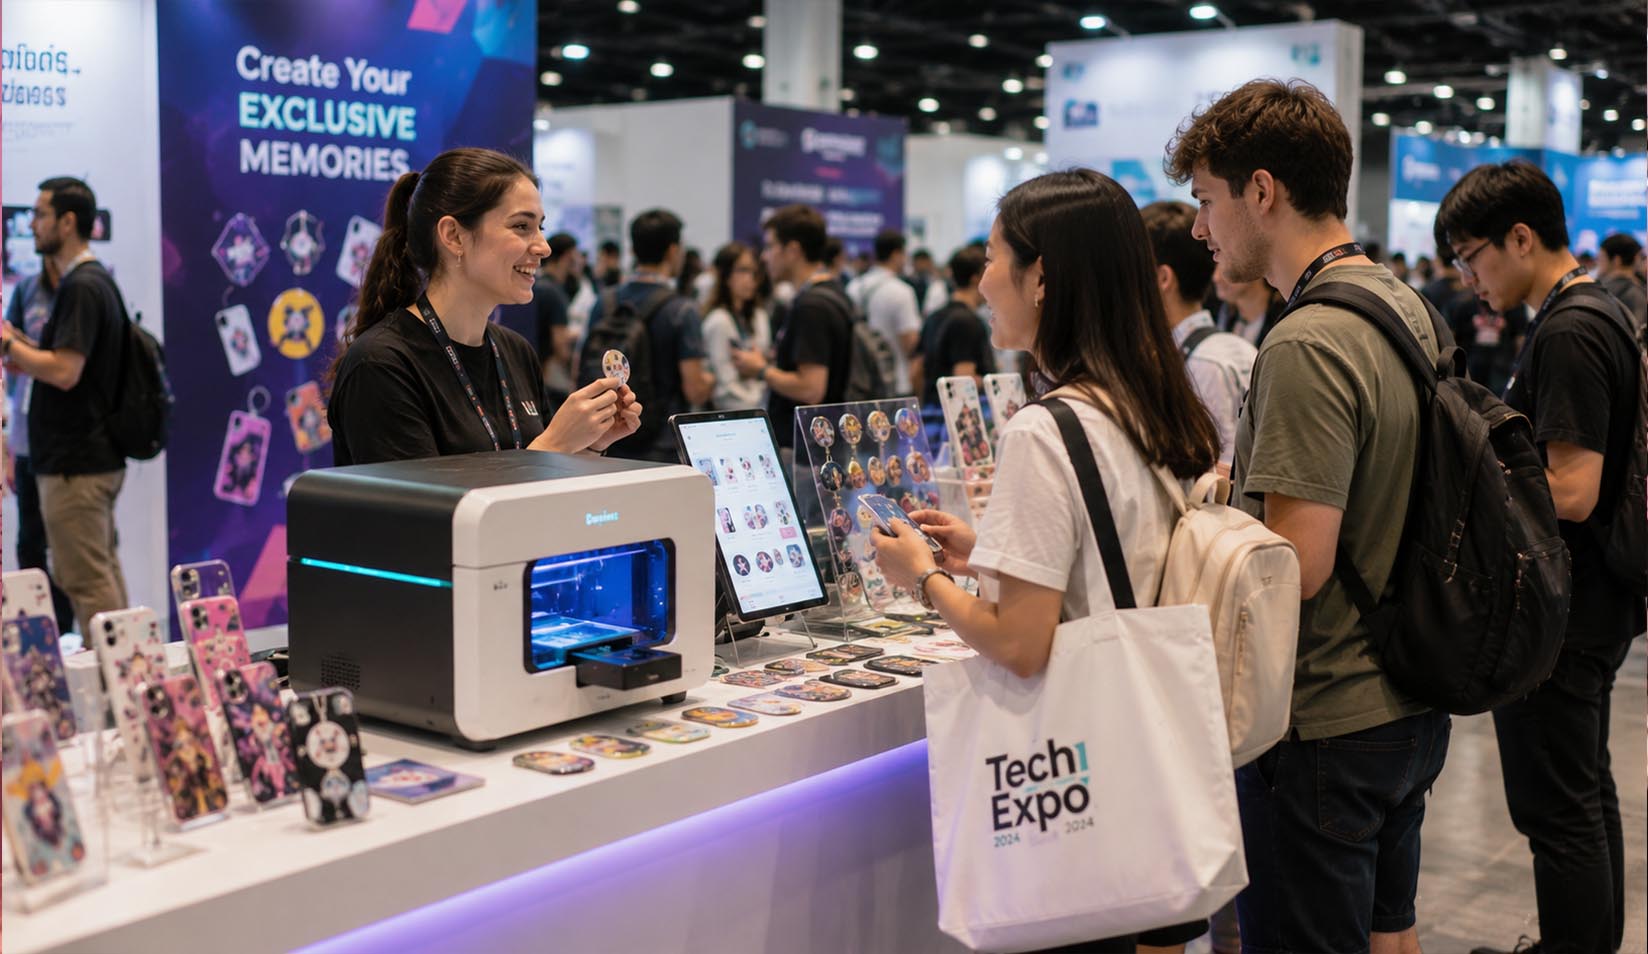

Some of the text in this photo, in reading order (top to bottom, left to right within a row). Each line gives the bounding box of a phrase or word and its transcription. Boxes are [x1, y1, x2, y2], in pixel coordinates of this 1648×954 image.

[236, 45, 412, 96] Create Your
[239, 91, 417, 141] EXCLUSIVE
[240, 138, 410, 181] MEMORIES
[991, 783, 1090, 832] Expo
[1065, 816, 1094, 834] 2024
